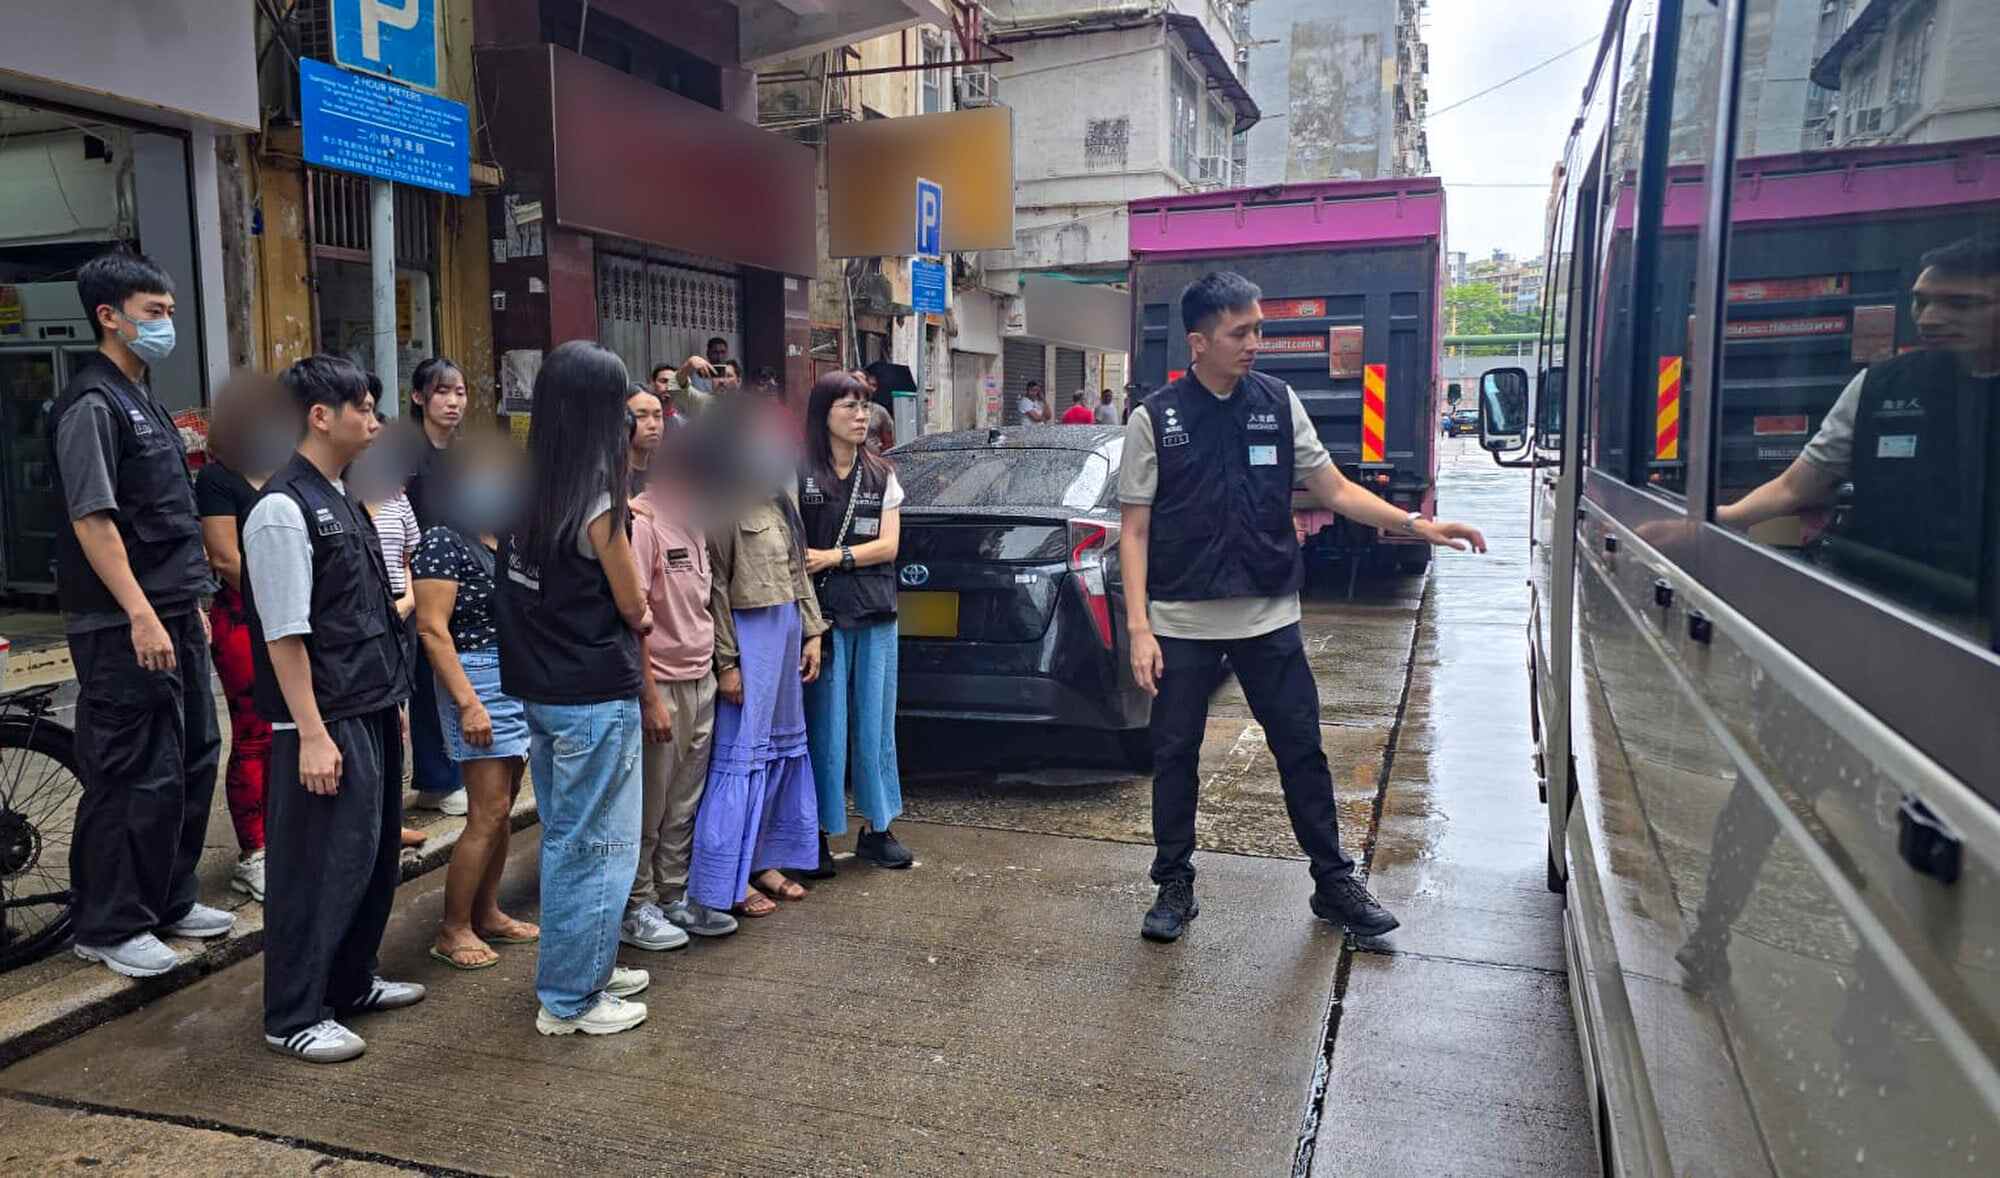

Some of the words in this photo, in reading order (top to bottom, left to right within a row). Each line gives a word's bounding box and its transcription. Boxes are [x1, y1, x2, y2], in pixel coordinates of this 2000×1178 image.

[361, 0, 419, 62] P
[353, 75, 360, 85] 2
[361, 78, 387, 92] HOUR
[389, 85, 423, 102] METERS
[922, 190, 936, 248] P
